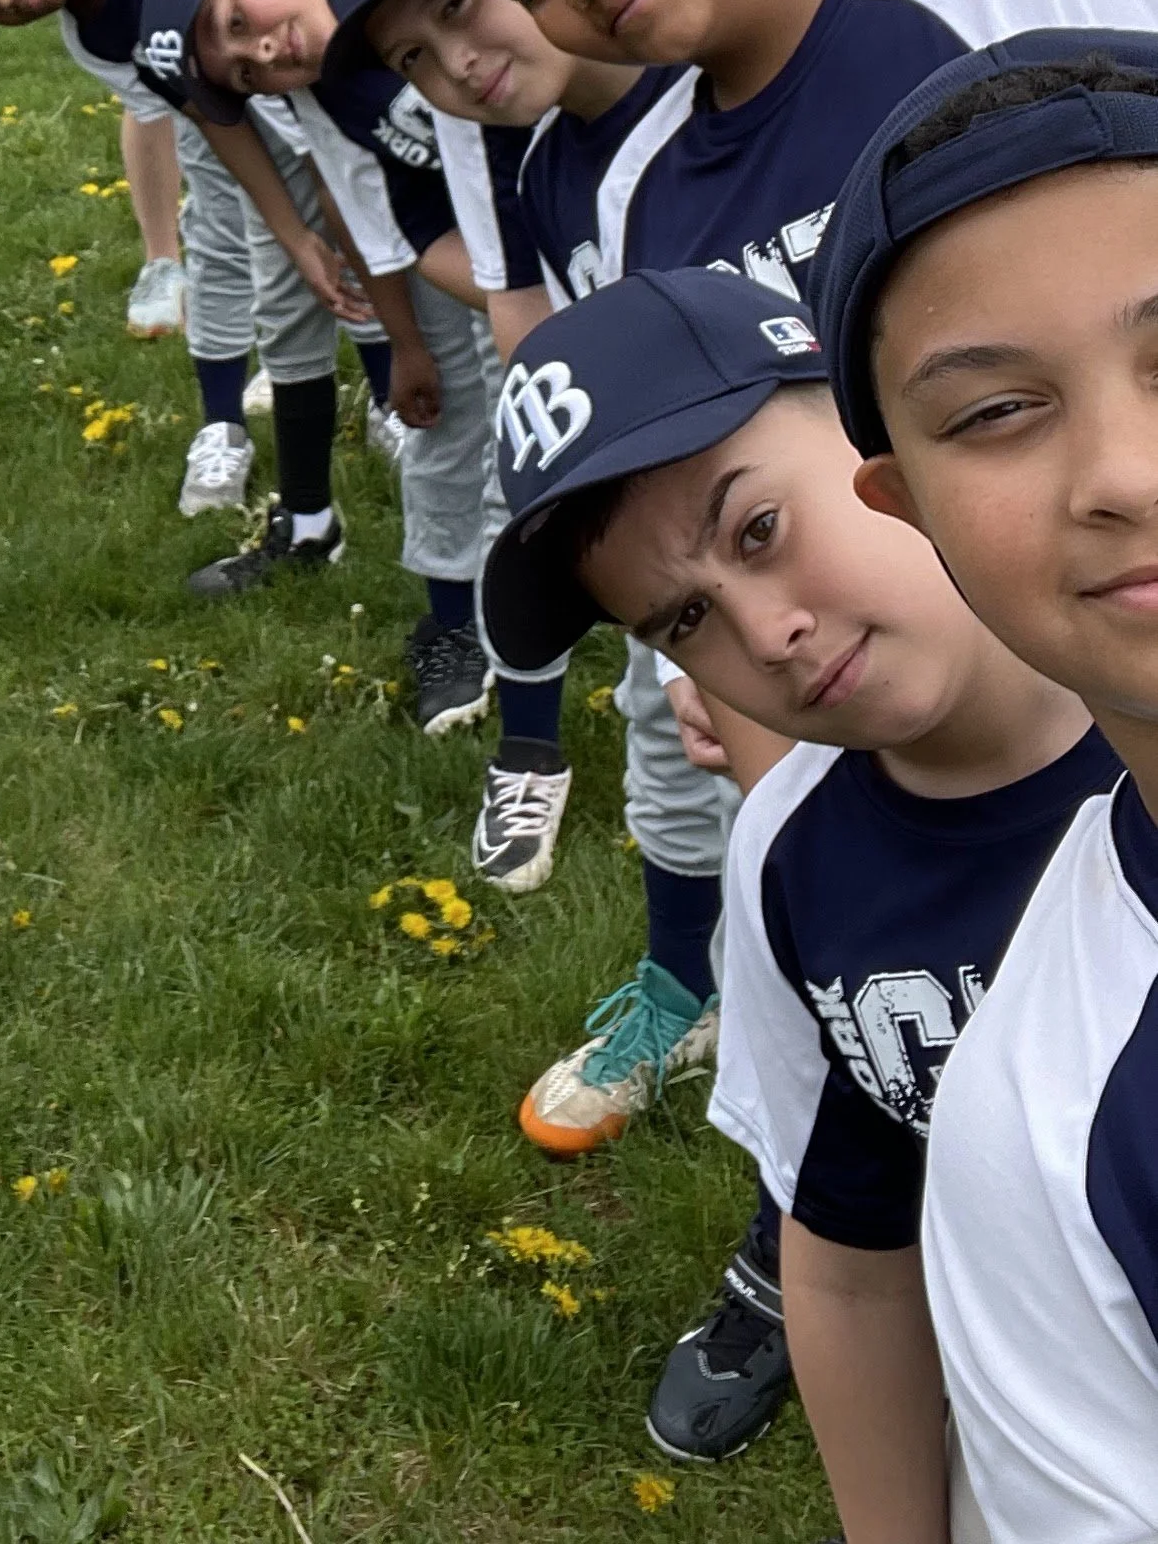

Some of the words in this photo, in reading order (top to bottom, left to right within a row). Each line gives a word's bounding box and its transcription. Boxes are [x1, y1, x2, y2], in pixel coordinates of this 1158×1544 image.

[145, 29, 184, 80] TB
[371, 116, 442, 170] ORK
[496, 361, 592, 473] TB
